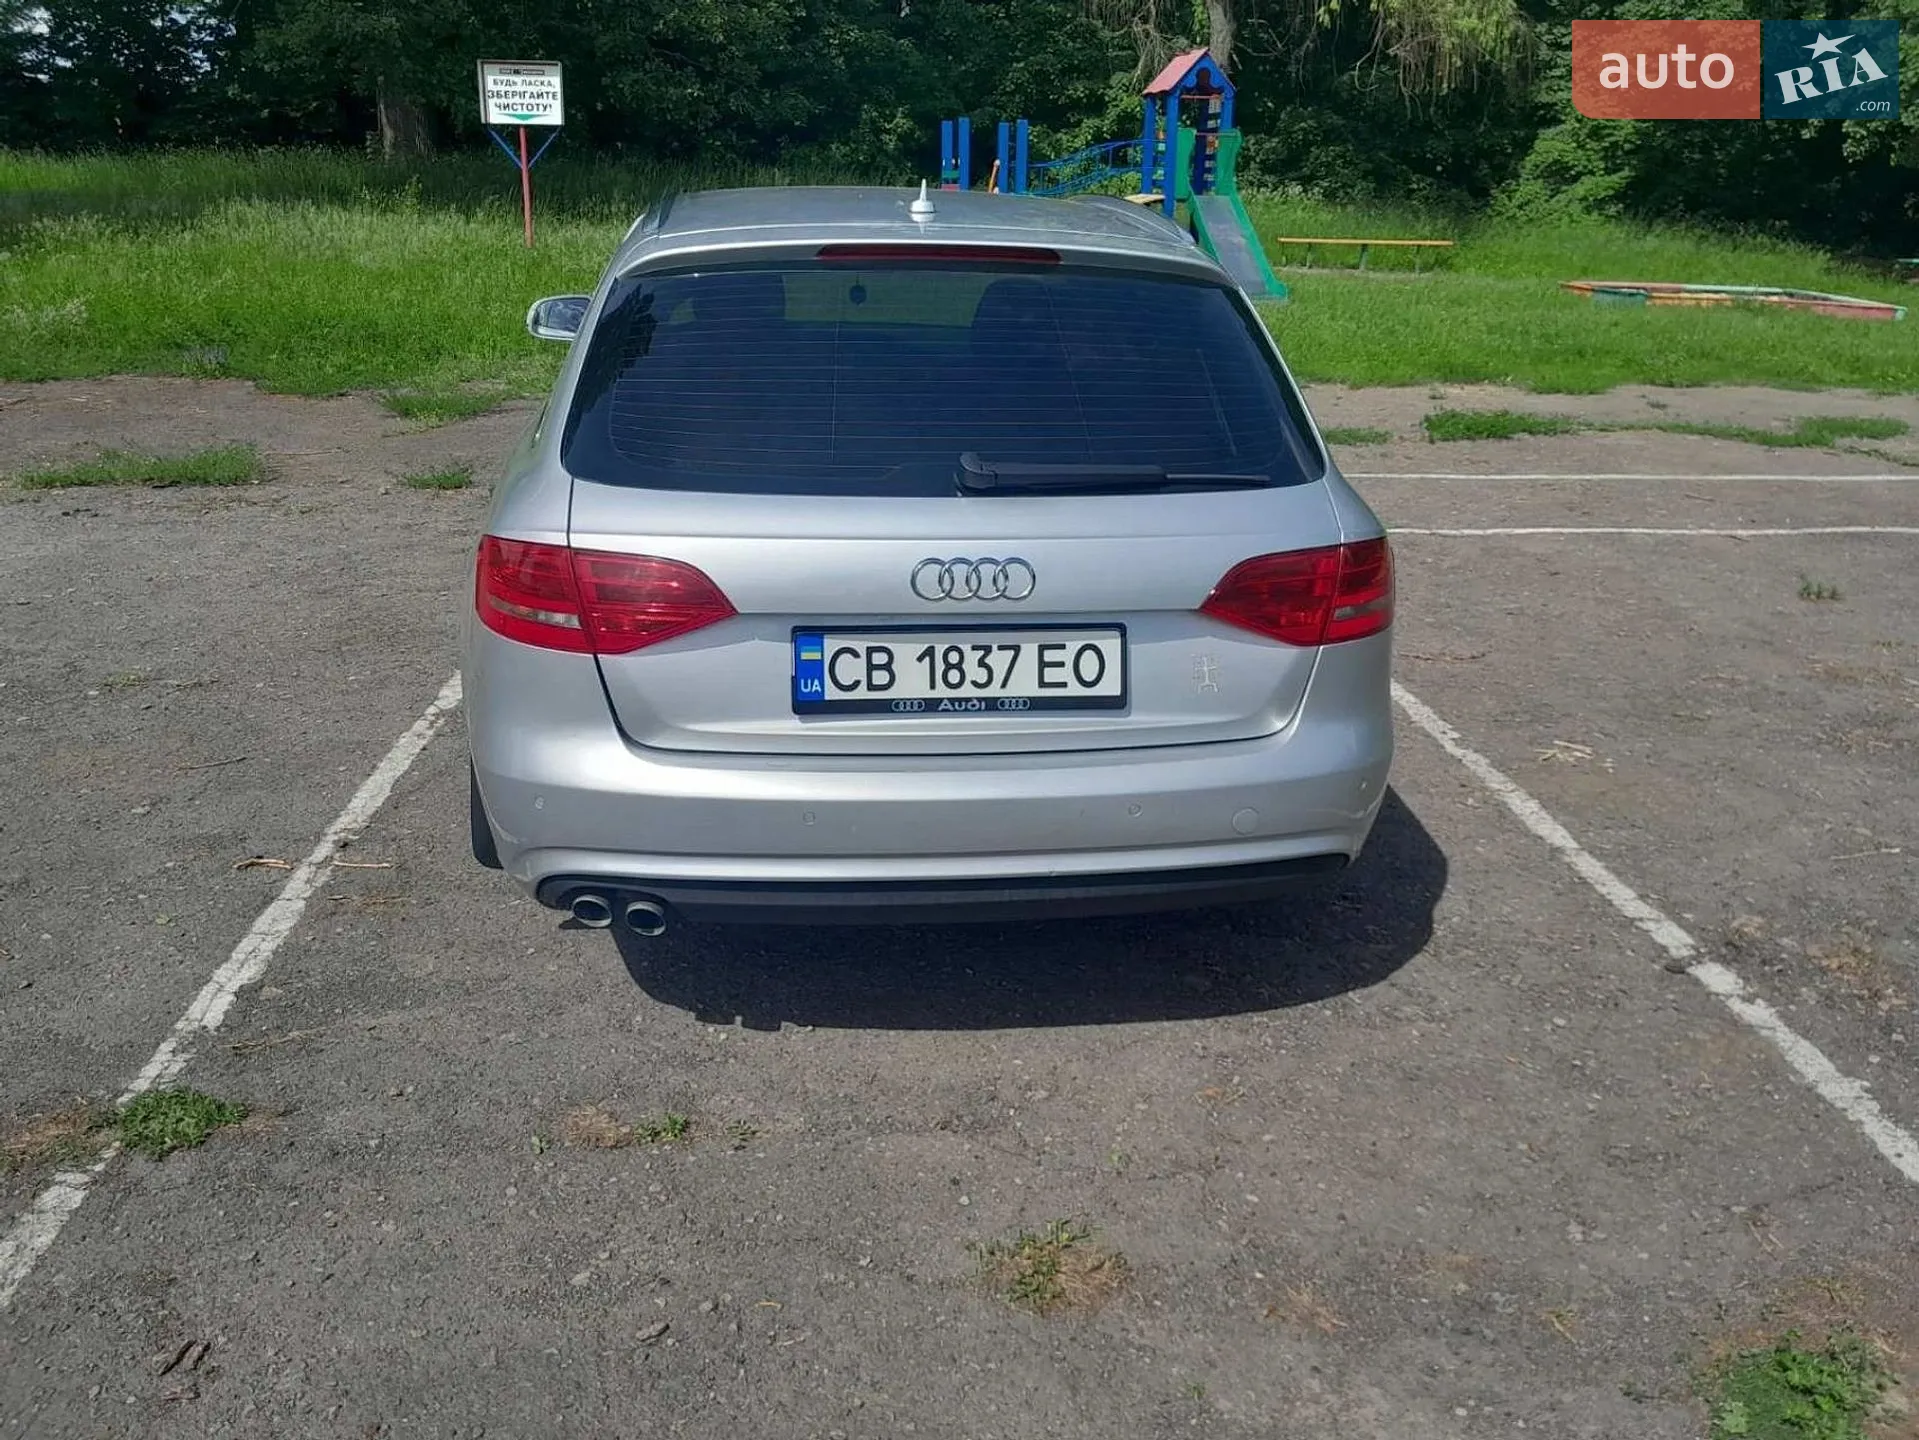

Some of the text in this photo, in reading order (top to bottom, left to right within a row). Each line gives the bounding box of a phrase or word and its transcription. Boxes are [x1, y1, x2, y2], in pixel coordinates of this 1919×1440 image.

[493, 79, 556, 89] БУДЬ ЛАСКА,
[487, 89, 558, 101] ЗБЕРІГАЙТЕ
[494, 102, 553, 112] ЧИСТОТУ!
[828, 643, 1106, 692] CB 1837 EO
[801, 679, 822, 694] UA
[937, 699, 986, 712] Audi
